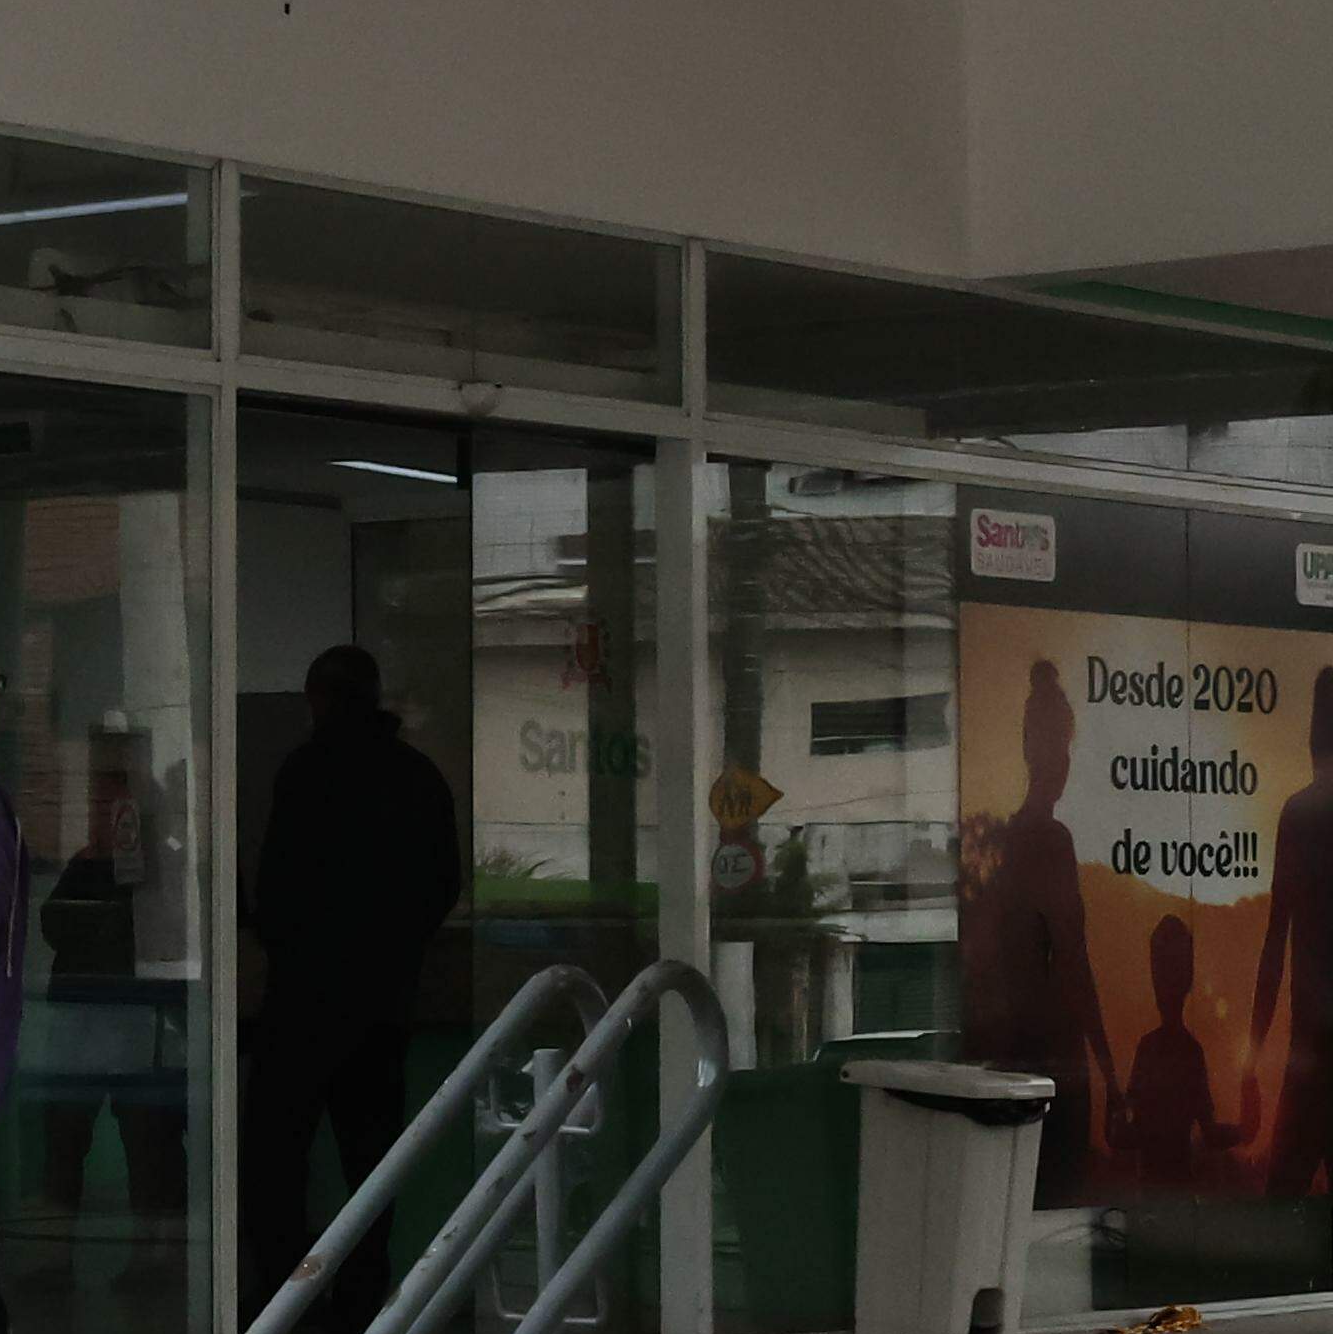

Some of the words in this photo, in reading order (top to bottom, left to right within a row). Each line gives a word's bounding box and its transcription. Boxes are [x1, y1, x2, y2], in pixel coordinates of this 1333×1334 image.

[1087, 656, 1184, 709] Desde
[1192, 664, 1278, 715] 2020
[1110, 744, 1258, 796] cuidando
[1111, 828, 1151, 876] de
[1160, 831, 1259, 879] você!!!
